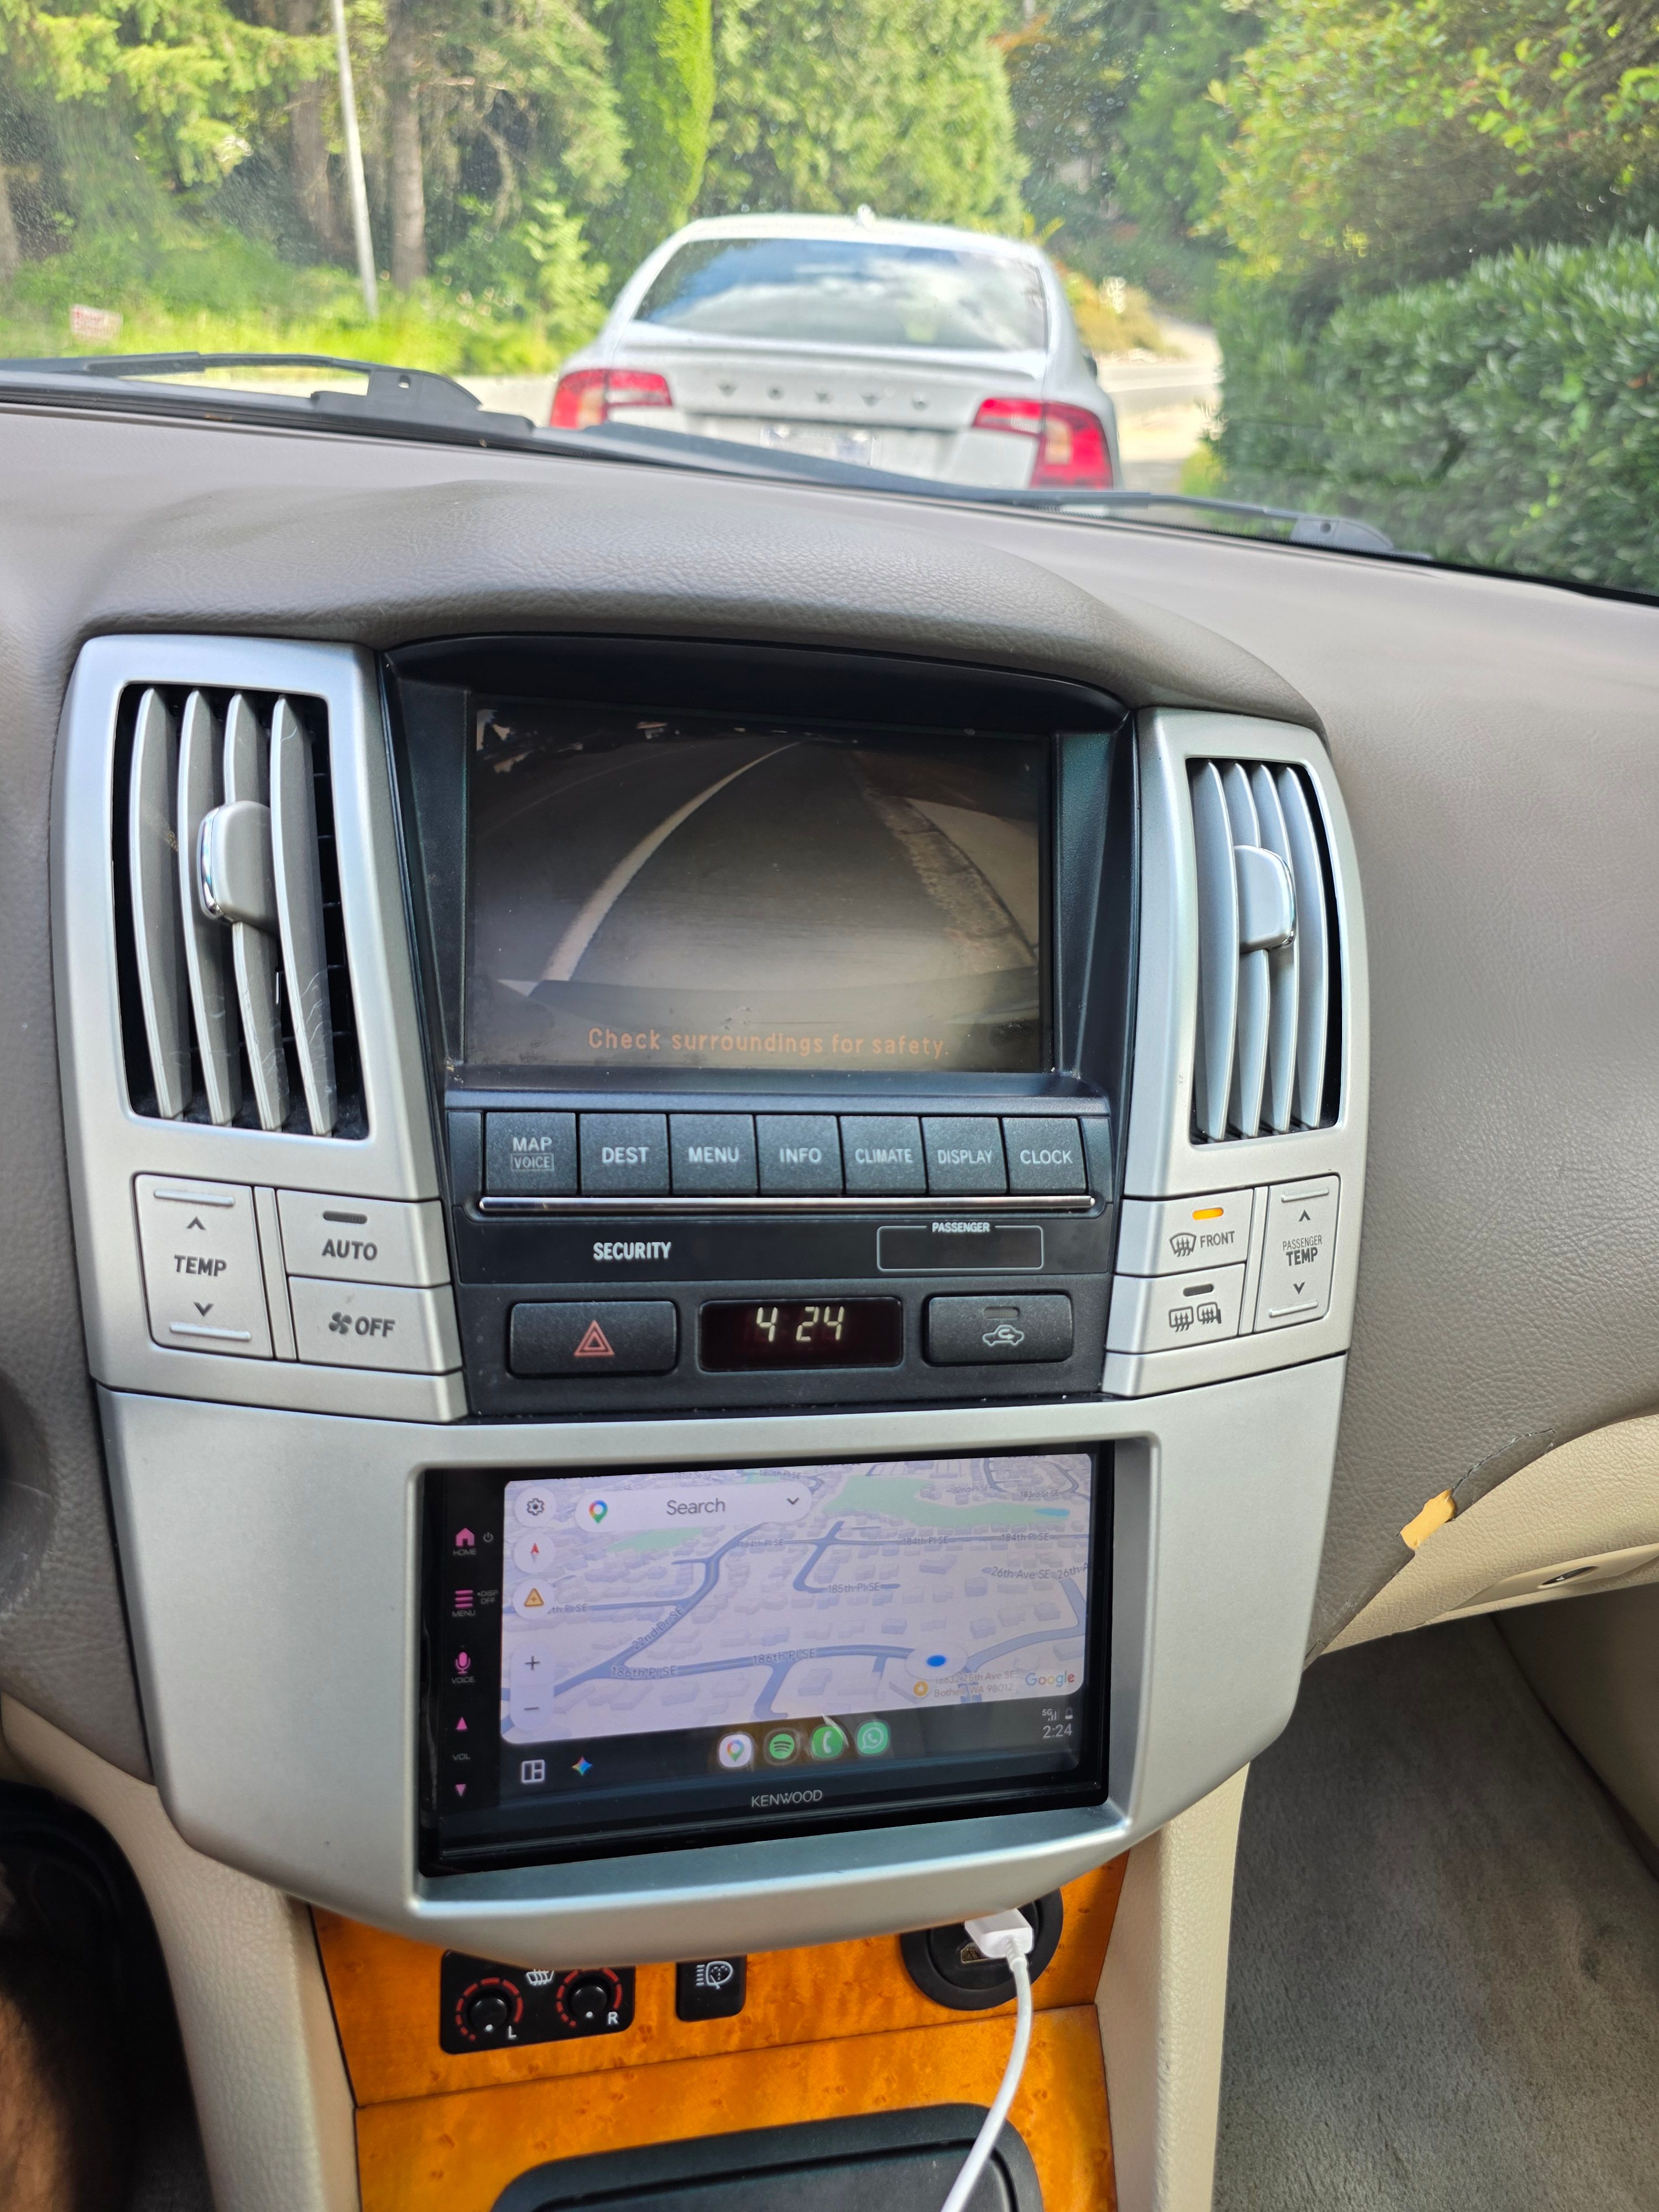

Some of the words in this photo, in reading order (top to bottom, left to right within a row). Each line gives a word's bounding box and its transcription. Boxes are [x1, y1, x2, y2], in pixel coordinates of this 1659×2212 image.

[588, 1027, 660, 1050] Check
[671, 1033, 823, 1056] surroundings
[832, 1034, 864, 1053] for
[872, 1036, 950, 1059] safety.
[512, 1136, 552, 1152] MAP
[602, 1146, 650, 1164] DEST
[688, 1146, 739, 1163] MENU
[780, 1147, 821, 1162] INFO
[855, 1149, 913, 1164] CLIMATE
[937, 1149, 993, 1165] DISPLAY
[1020, 1150, 1073, 1164] CLOCK
[514, 1156, 551, 1170] VOICE
[932, 1222, 990, 1233] PASSENGER
[1200, 1230, 1235, 1248] FRONT
[1282, 1234, 1323, 1251] PASSENGER
[321, 1238, 378, 1261] AUTO
[593, 1241, 671, 1261] SECURITY
[1286, 1247, 1318, 1266] TEMP
[174, 1254, 227, 1277] TEMP
[354, 1316, 395, 1337] OFF
[666, 1498, 726, 1515] Search
[938, 1536, 949, 1544] SE
[1039, 1532, 1050, 1541] SE
[991, 1566, 1014, 1579] 26th
[1016, 1569, 1036, 1579] Ave
[1039, 1569, 1051, 1579] SE
[1057, 1566, 1080, 1580] 26th
[828, 1584, 854, 1593] 185th
[869, 1582, 880, 1591] SE
[576, 1603, 588, 1613] SE
[632, 1627, 658, 1649] 22nd
[657, 1616, 671, 1631] Dr
[670, 1606, 685, 1620] SE
[753, 1653, 785, 1665] 186th
[802, 1648, 817, 1659] SE
[612, 1666, 645, 1677] 186th
[662, 1665, 677, 1676] SE
[962, 1673, 983, 1682] 25th
[985, 1671, 1003, 1680] Ave
[1025, 1670, 1075, 1688] Google
[969, 1685, 984, 1694] WA
[987, 1683, 1013, 1692] 98012
[1042, 1723, 1073, 1739] 2:24
[752, 1790, 823, 1808] KENWOOD
[608, 2011, 618, 2026] R
[508, 2026, 517, 2039] L
